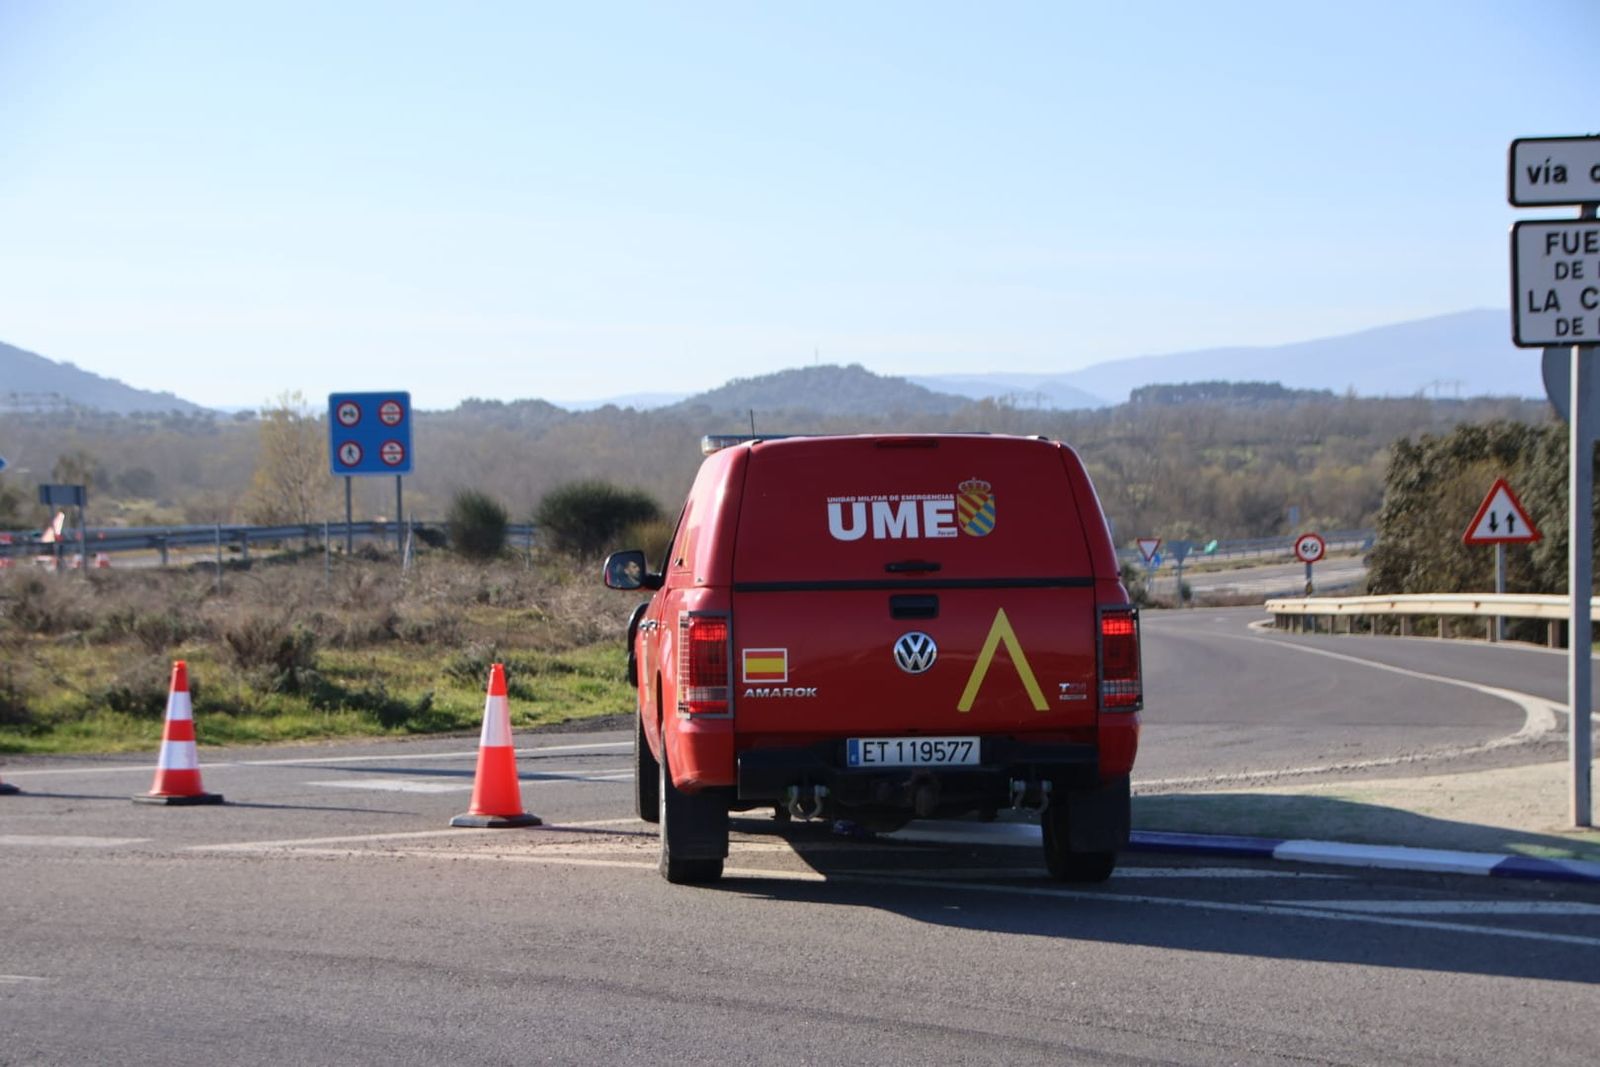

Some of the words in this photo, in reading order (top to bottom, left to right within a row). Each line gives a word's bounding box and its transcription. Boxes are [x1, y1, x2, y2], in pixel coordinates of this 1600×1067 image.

[1527, 156, 1568, 185] vía
[1555, 261, 1584, 280] DE
[1528, 288, 1561, 313] LA
[1555, 317, 1584, 337] DE
[827, 500, 958, 541] UME
[744, 687, 818, 698] AMAROK
